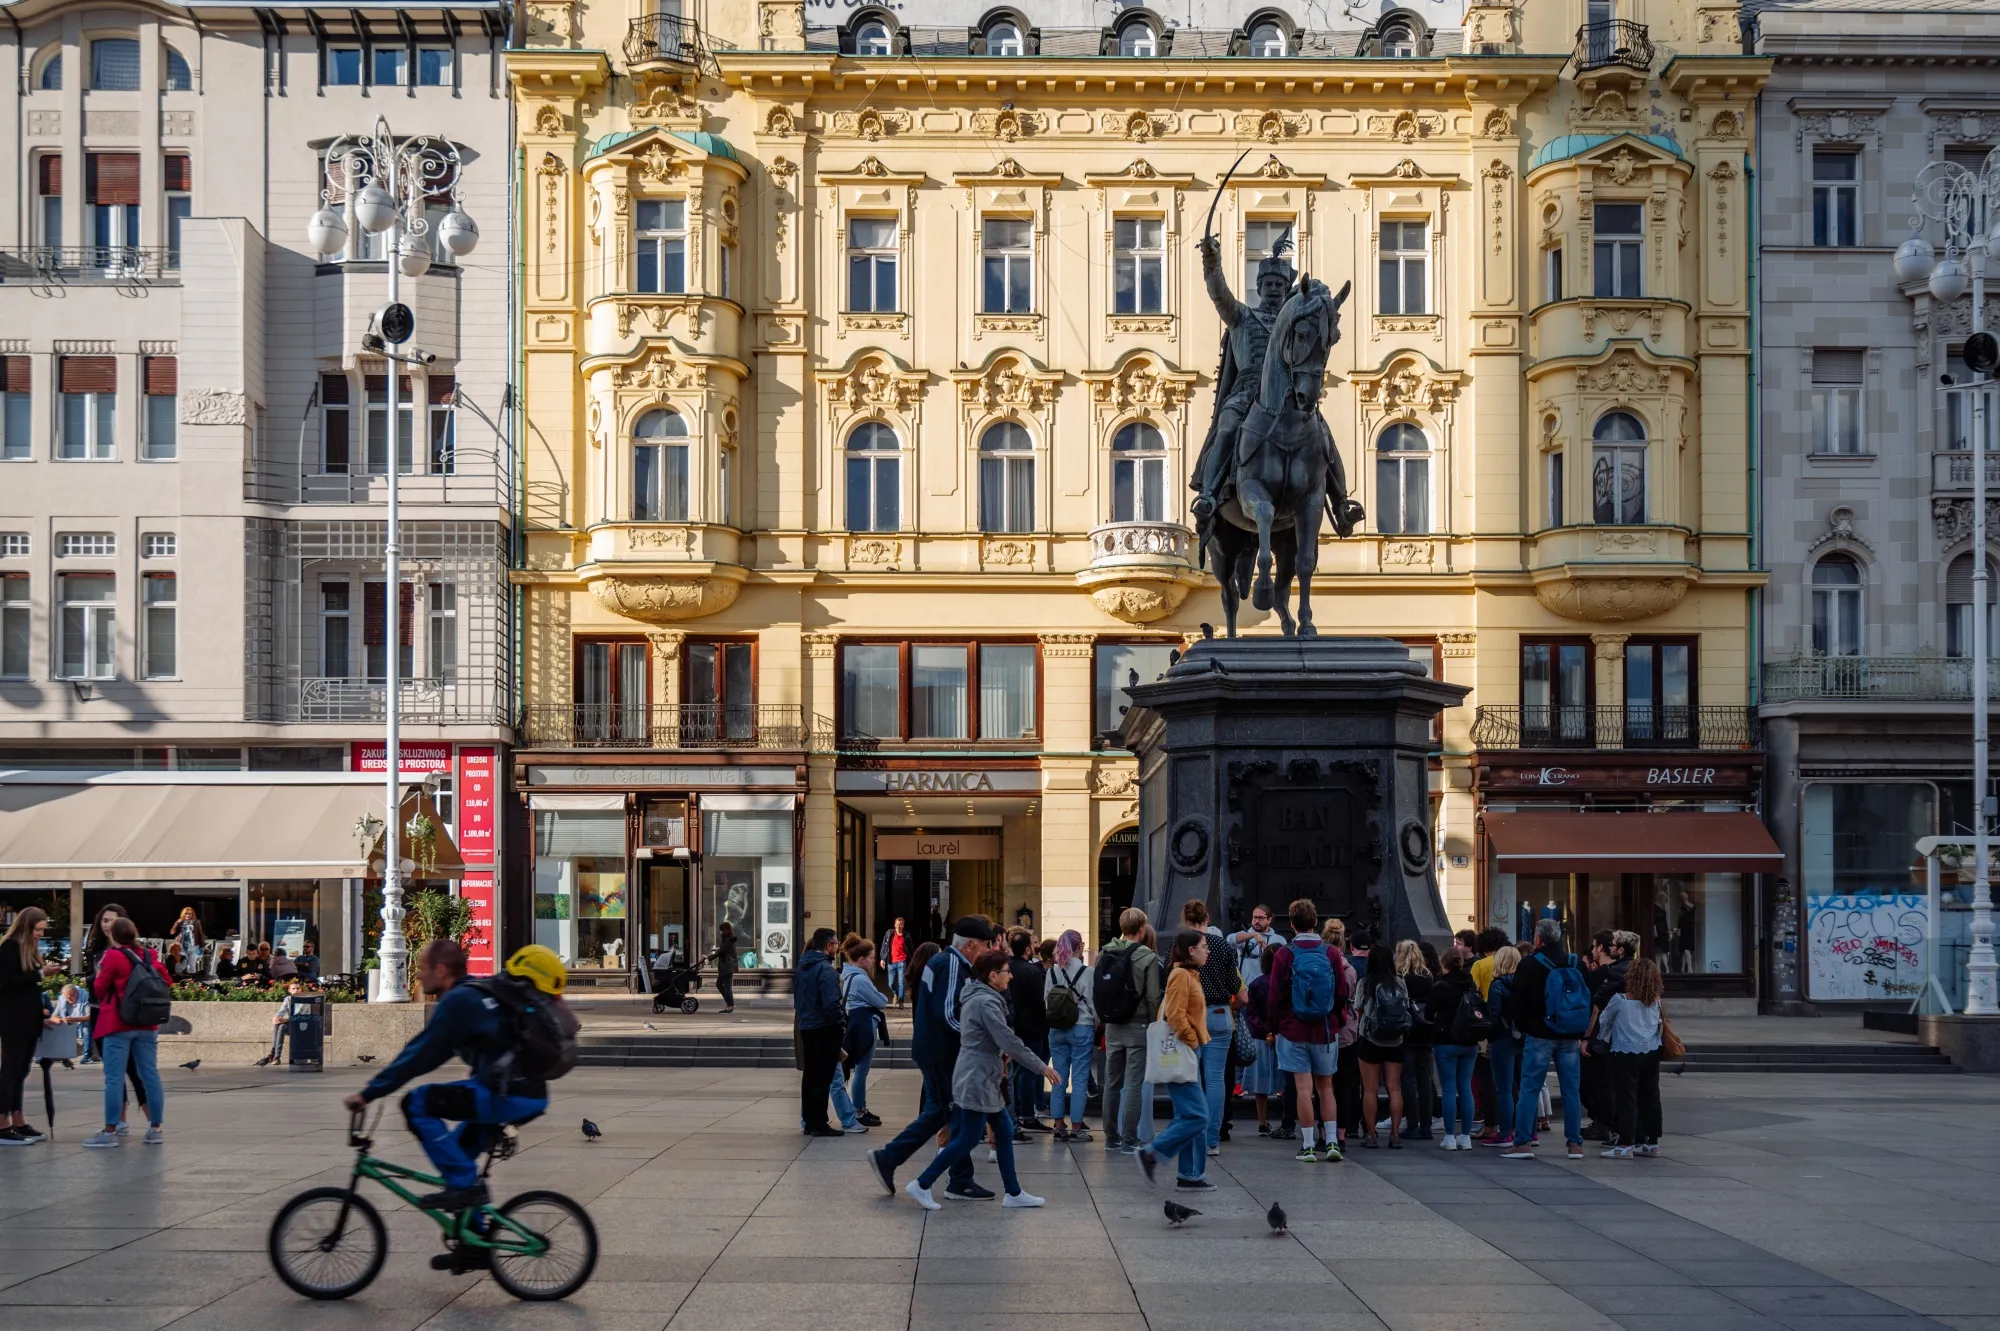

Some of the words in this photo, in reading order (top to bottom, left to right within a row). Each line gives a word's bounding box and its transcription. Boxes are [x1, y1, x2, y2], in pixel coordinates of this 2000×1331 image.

[361, 748, 387, 758] ZAKUP
[397, 748, 446, 758] SKLUZIVNOG
[361, 759, 404, 769] UREDSG
[405, 759, 446, 769] PROSTORA
[466, 756, 488, 764] UREDSKI
[465, 769, 489, 778] PROSTORI
[1646, 768, 1716, 784] BASLER
[885, 772, 994, 791] HARMICA
[917, 840, 960, 855] Laurèl
